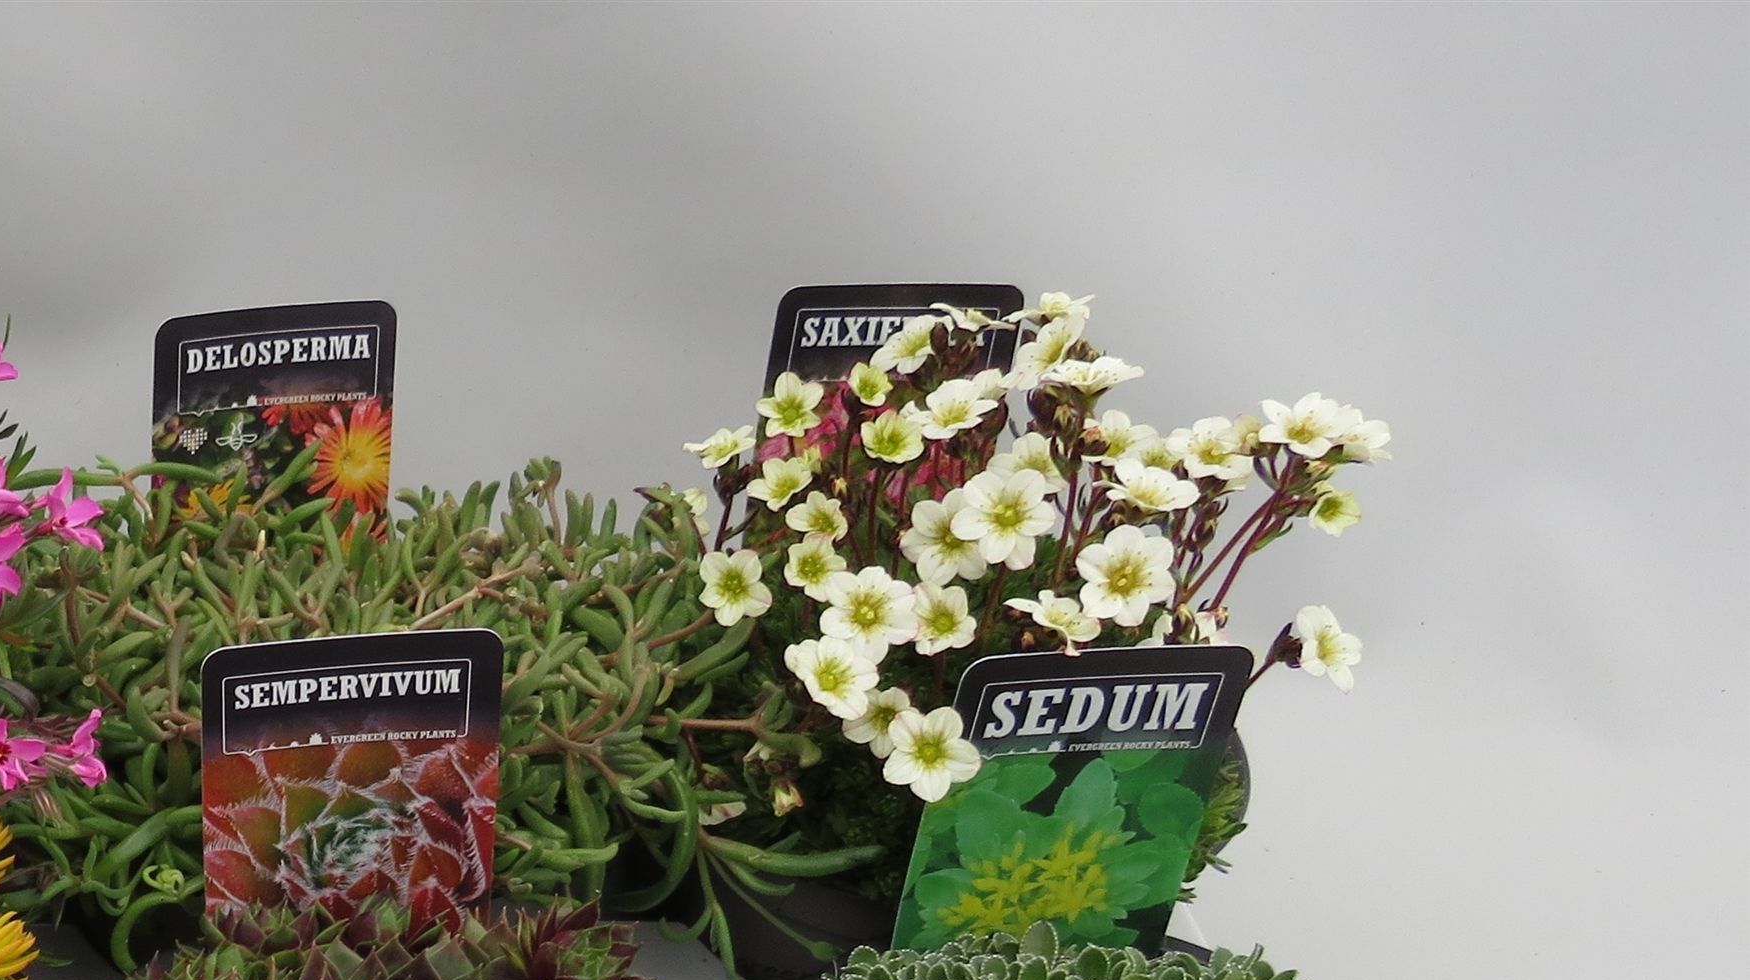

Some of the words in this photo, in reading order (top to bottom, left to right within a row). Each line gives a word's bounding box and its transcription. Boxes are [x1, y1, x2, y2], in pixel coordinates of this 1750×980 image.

[186, 334, 370, 374] DELOSPERMA
[264, 394, 309, 406] EVERGREEN
[310, 392, 337, 402] ROCKY
[336, 392, 368, 401] PLANTS
[234, 668, 462, 710] SEMPERVIVUM
[983, 682, 1210, 739] SEDUM
[330, 732, 387, 745] EVERGREEN
[387, 730, 419, 741] ROCKY
[419, 729, 458, 740] PLANTS
[1068, 741, 1122, 752] EVERGREEN
[1122, 741, 1154, 750] ROCKY
[1153, 740, 1191, 749] PLANTS
